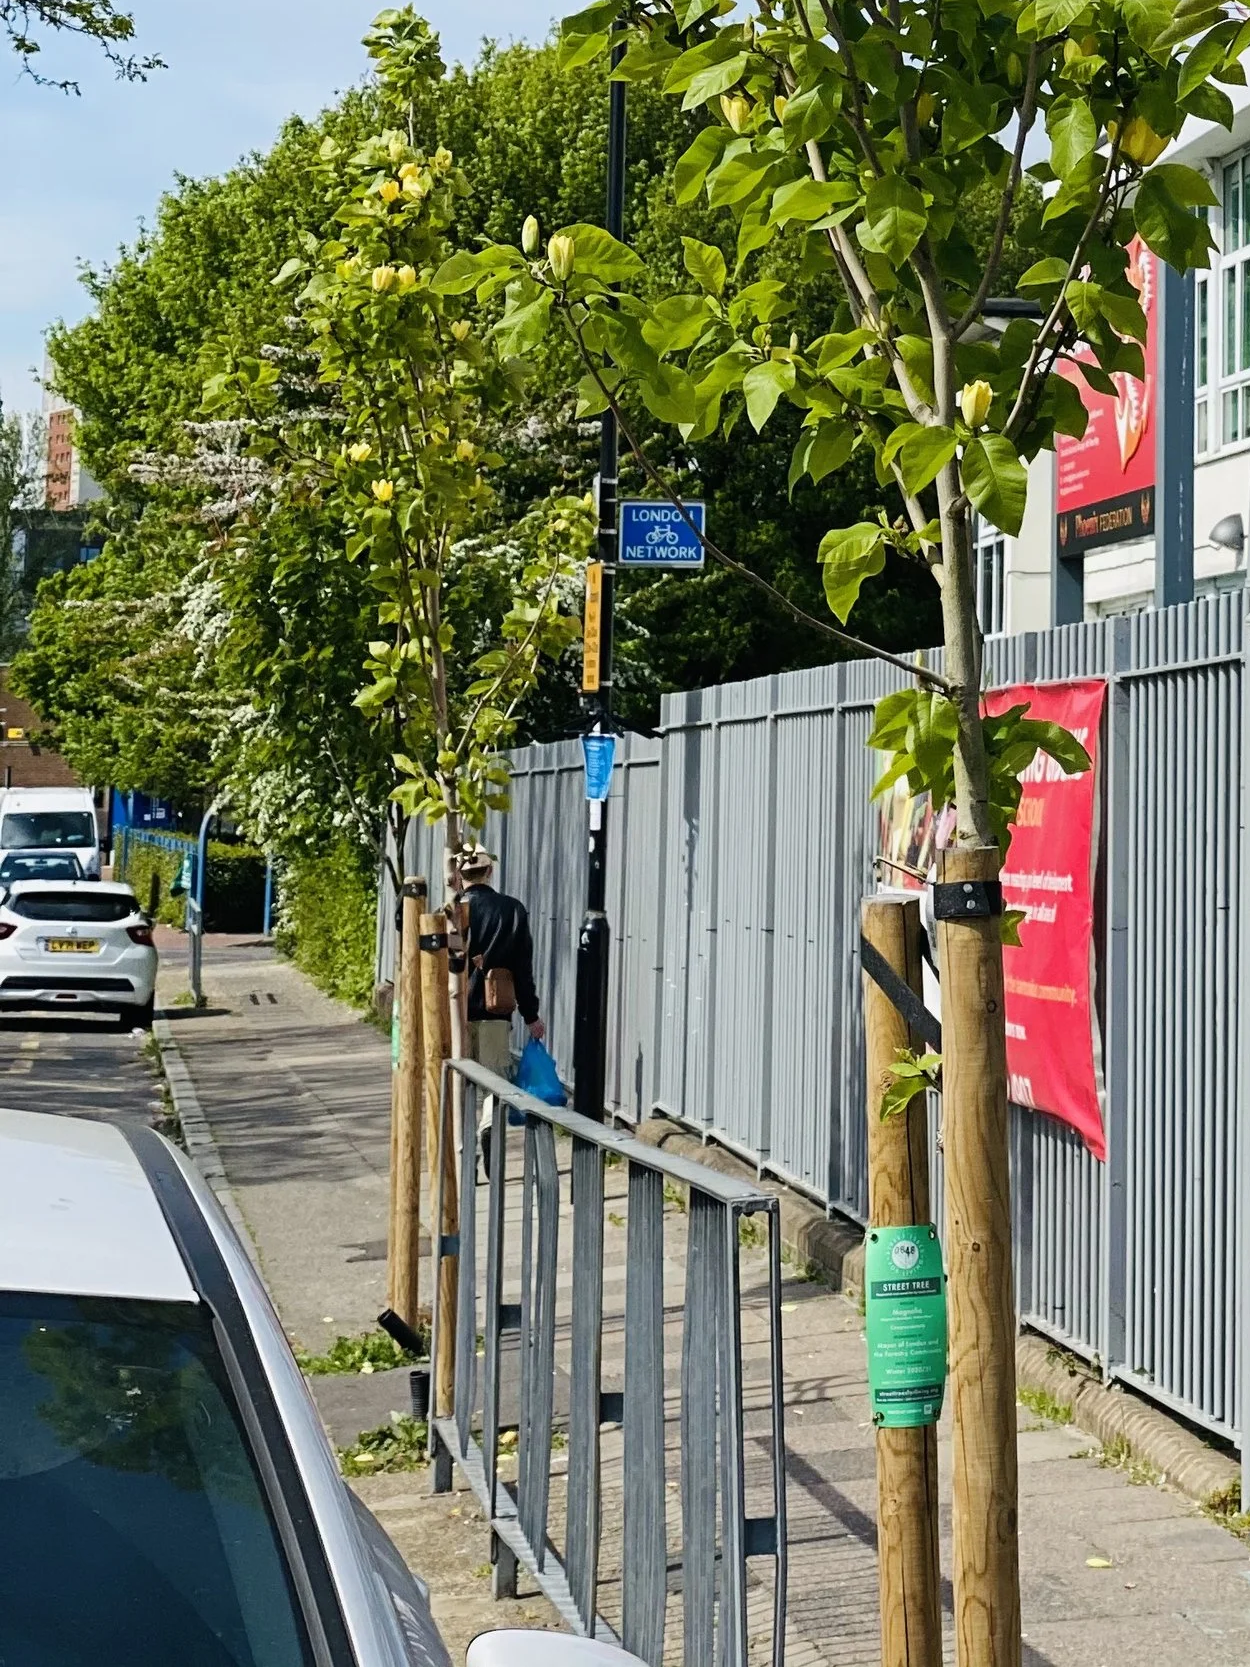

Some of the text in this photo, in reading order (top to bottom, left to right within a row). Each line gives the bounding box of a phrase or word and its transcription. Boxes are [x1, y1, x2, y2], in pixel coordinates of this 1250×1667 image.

[1075, 506, 1133, 538] Phoenix FEDERATION
[626, 546, 697, 559] NETWORK
[882, 1280, 930, 1292] STREET TREE
[892, 1307, 923, 1317] Magnolia
[885, 1367, 906, 1375] Winter
